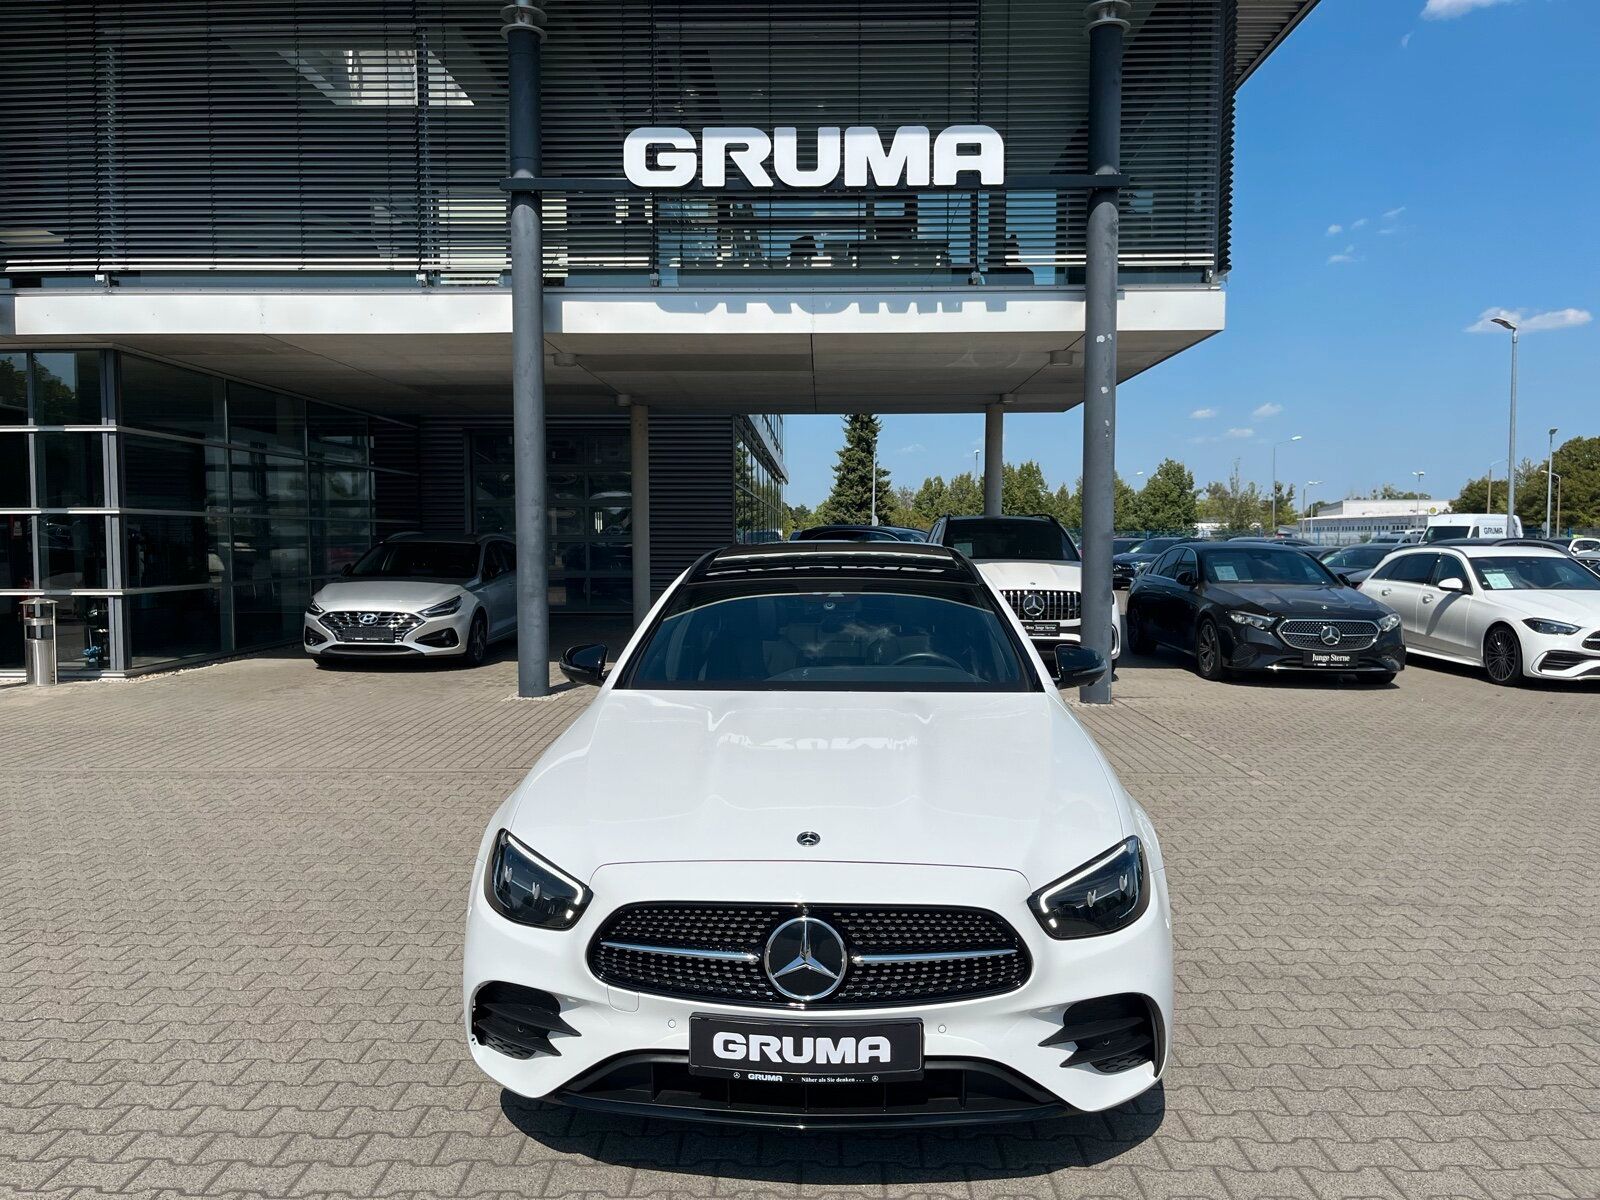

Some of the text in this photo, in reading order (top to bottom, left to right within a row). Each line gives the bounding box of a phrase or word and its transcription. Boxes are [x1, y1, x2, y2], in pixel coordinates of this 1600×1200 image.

[623, 125, 1004, 187] GRUMA
[1312, 653, 1350, 662] Junge Sterne
[712, 1031, 891, 1064] GRUMA
[747, 1073, 783, 1082] GRUMA
